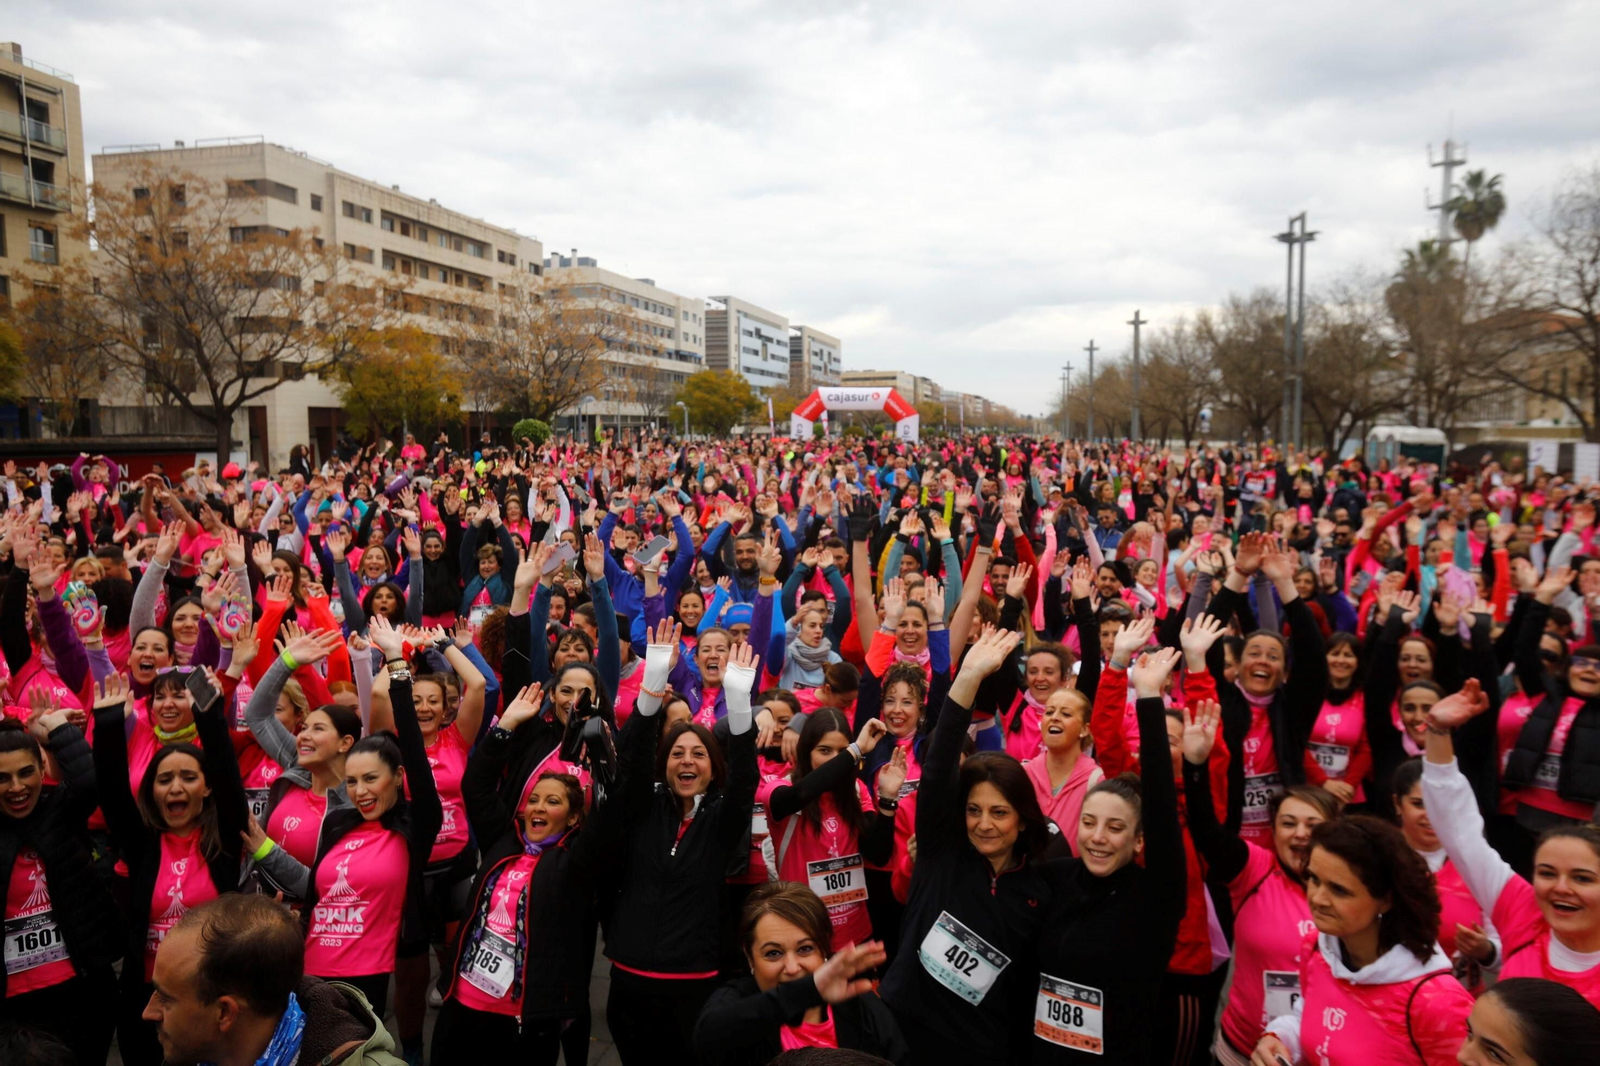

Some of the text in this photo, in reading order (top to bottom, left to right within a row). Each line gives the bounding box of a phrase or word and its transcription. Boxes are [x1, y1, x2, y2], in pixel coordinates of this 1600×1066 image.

[827, 392, 870, 404] cajasur
[823, 871, 852, 891] 1807
[14, 926, 61, 953] 1601
[320, 938, 342, 947] 2023
[475, 949, 503, 974] 185
[944, 944, 979, 977] 402
[1047, 998, 1084, 1027] 1988
